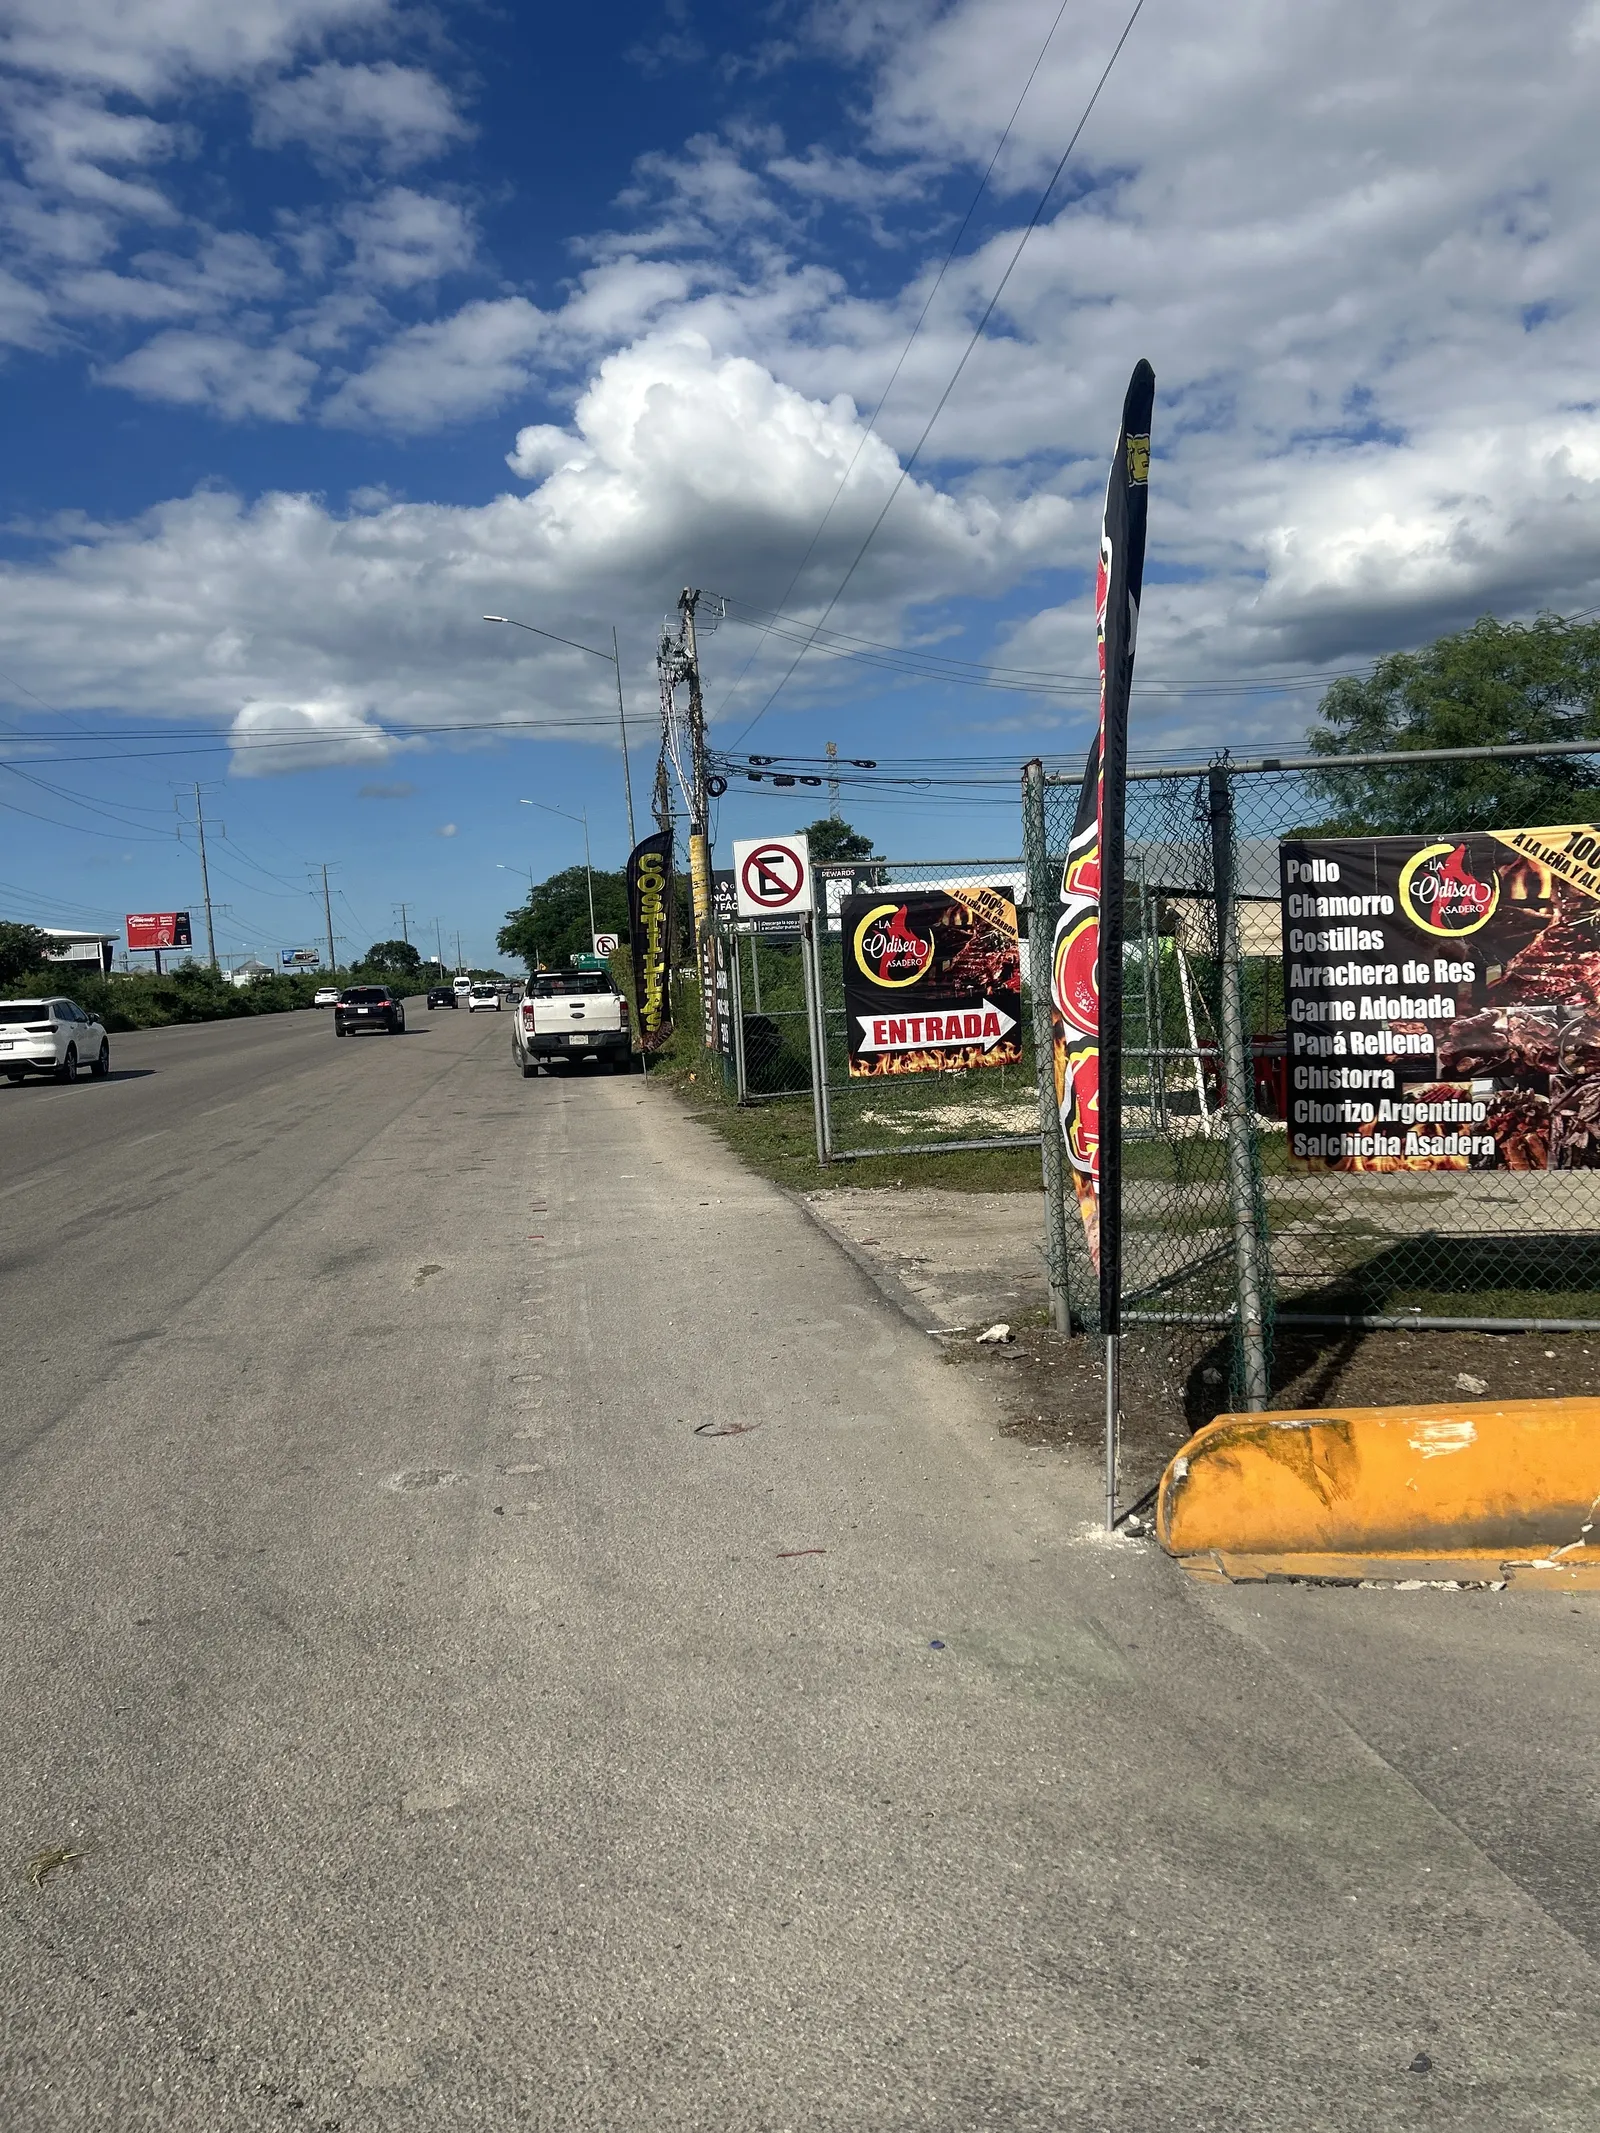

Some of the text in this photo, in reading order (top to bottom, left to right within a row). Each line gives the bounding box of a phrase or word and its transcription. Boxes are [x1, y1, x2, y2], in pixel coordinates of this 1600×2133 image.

[1287, 859, 1340, 883] Pollo
[1512, 833, 1597, 889] A LA LEÑA Y AL
[821, 870, 856, 878] REWARDS
[1410, 876, 1491, 903] Odisea
[954, 890, 960, 898] A
[959, 893, 968, 903] LA
[967, 899, 981, 913] LEÑA
[980, 908, 986, 916] Y
[984, 912, 992, 920] AL
[977, 891, 1005, 916] 100%
[1289, 894, 1394, 918] Chamorro
[1438, 904, 1485, 914] ASADERO
[637, 853, 666, 1031] COSTILLAS
[862, 934, 928, 959] Odisea
[1290, 927, 1384, 953] Costillas
[886, 958, 923, 967] ASADERO
[1290, 959, 1475, 987] Arrachera de Res
[1291, 994, 1455, 1022] Carne Adobada
[873, 1013, 1001, 1045] ENTRADA
[1293, 1031, 1434, 1057] Papá Rellena
[1294, 1066, 1395, 1089] Chistorra
[1294, 1099, 1486, 1124] Chorizo Argentino
[1294, 1131, 1495, 1156] Salchicha Asadera
